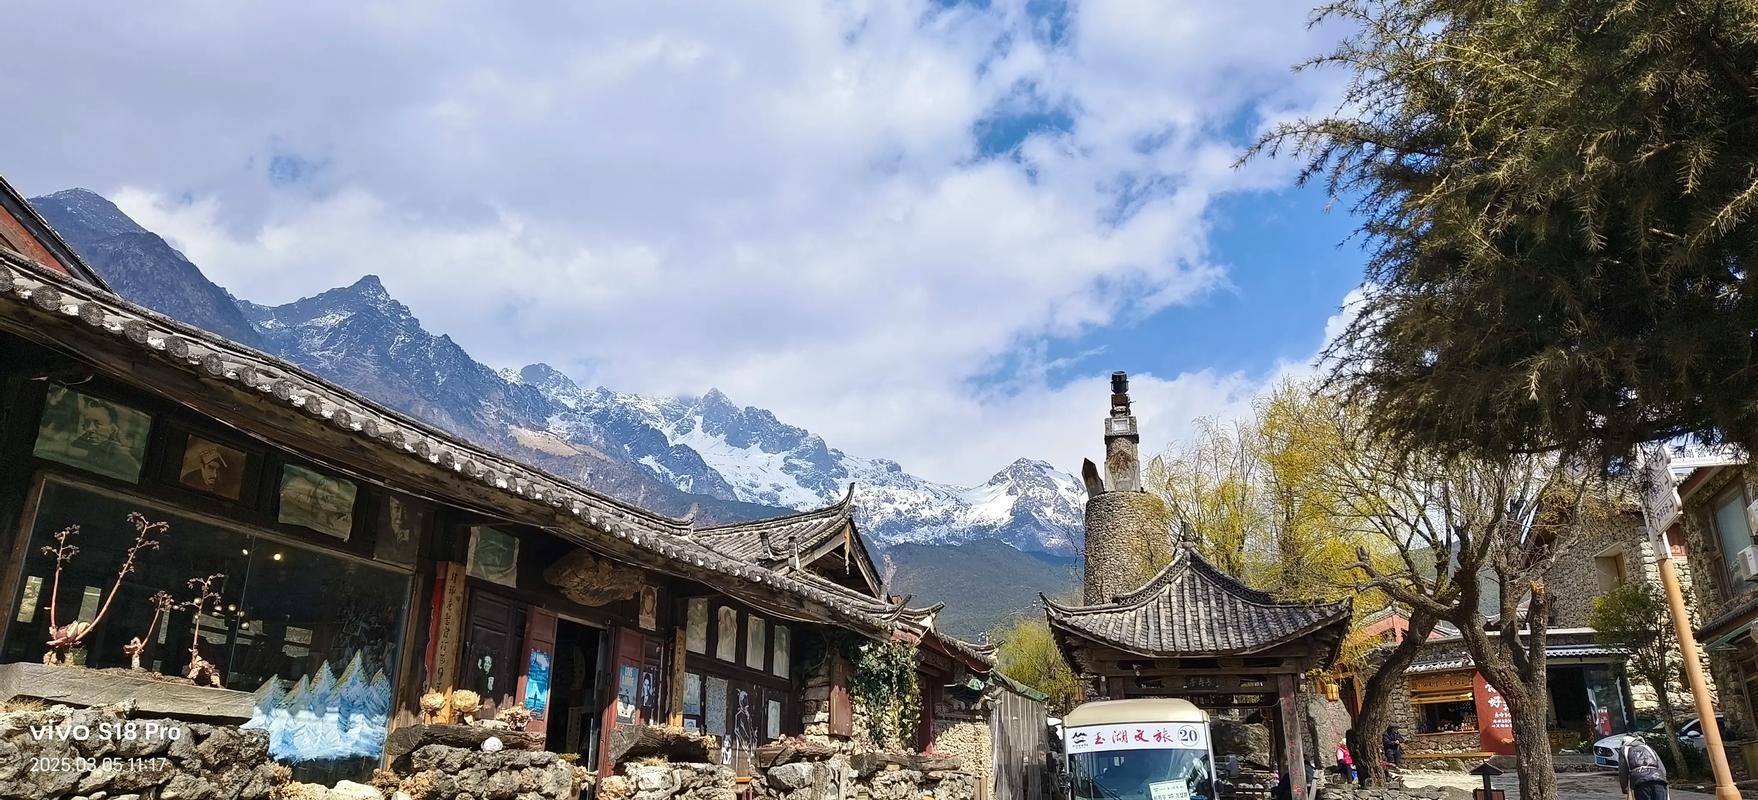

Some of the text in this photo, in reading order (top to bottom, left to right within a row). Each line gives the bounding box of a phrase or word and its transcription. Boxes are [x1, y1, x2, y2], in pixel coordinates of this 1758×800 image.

[1094, 728, 1174, 745] 玉湖文旅
[1179, 729, 1198, 742] 20
